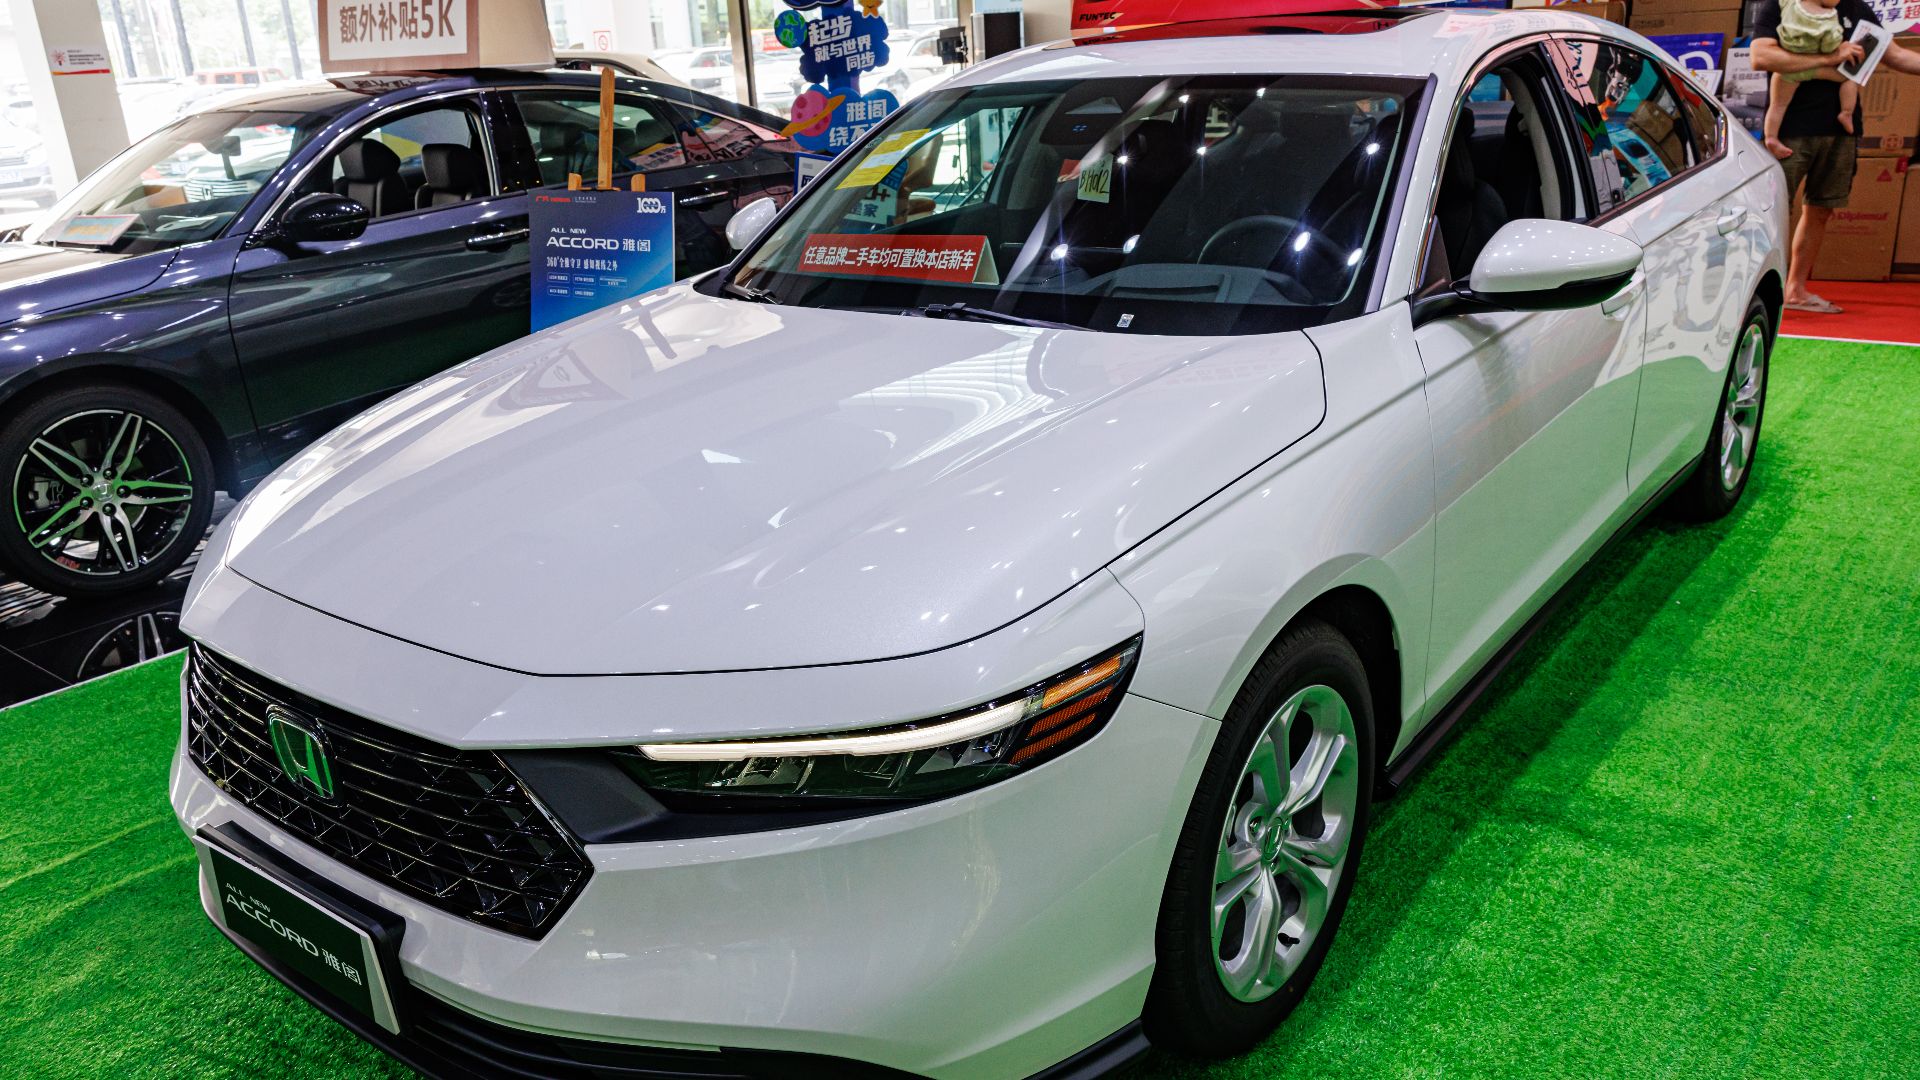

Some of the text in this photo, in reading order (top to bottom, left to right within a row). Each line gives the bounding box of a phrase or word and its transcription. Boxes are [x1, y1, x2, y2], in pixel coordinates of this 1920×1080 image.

[339, 0, 455, 43] 额外补贴5K
[1080, 12, 1116, 21] FUNTEC
[808, 15, 852, 47] 起步
[814, 34, 872, 62] 就与世界
[846, 51, 875, 72] 同步
[846, 99, 887, 122] 雅阁
[829, 122, 878, 147] 绕不
[546, 236, 651, 252] ACCORD 雅阁
[803, 247, 976, 271] 任意品牌二手车均可置换本店新车
[225, 882, 271, 913] ALL NEW
[226, 893, 362, 985] ACCORD 雅阁
